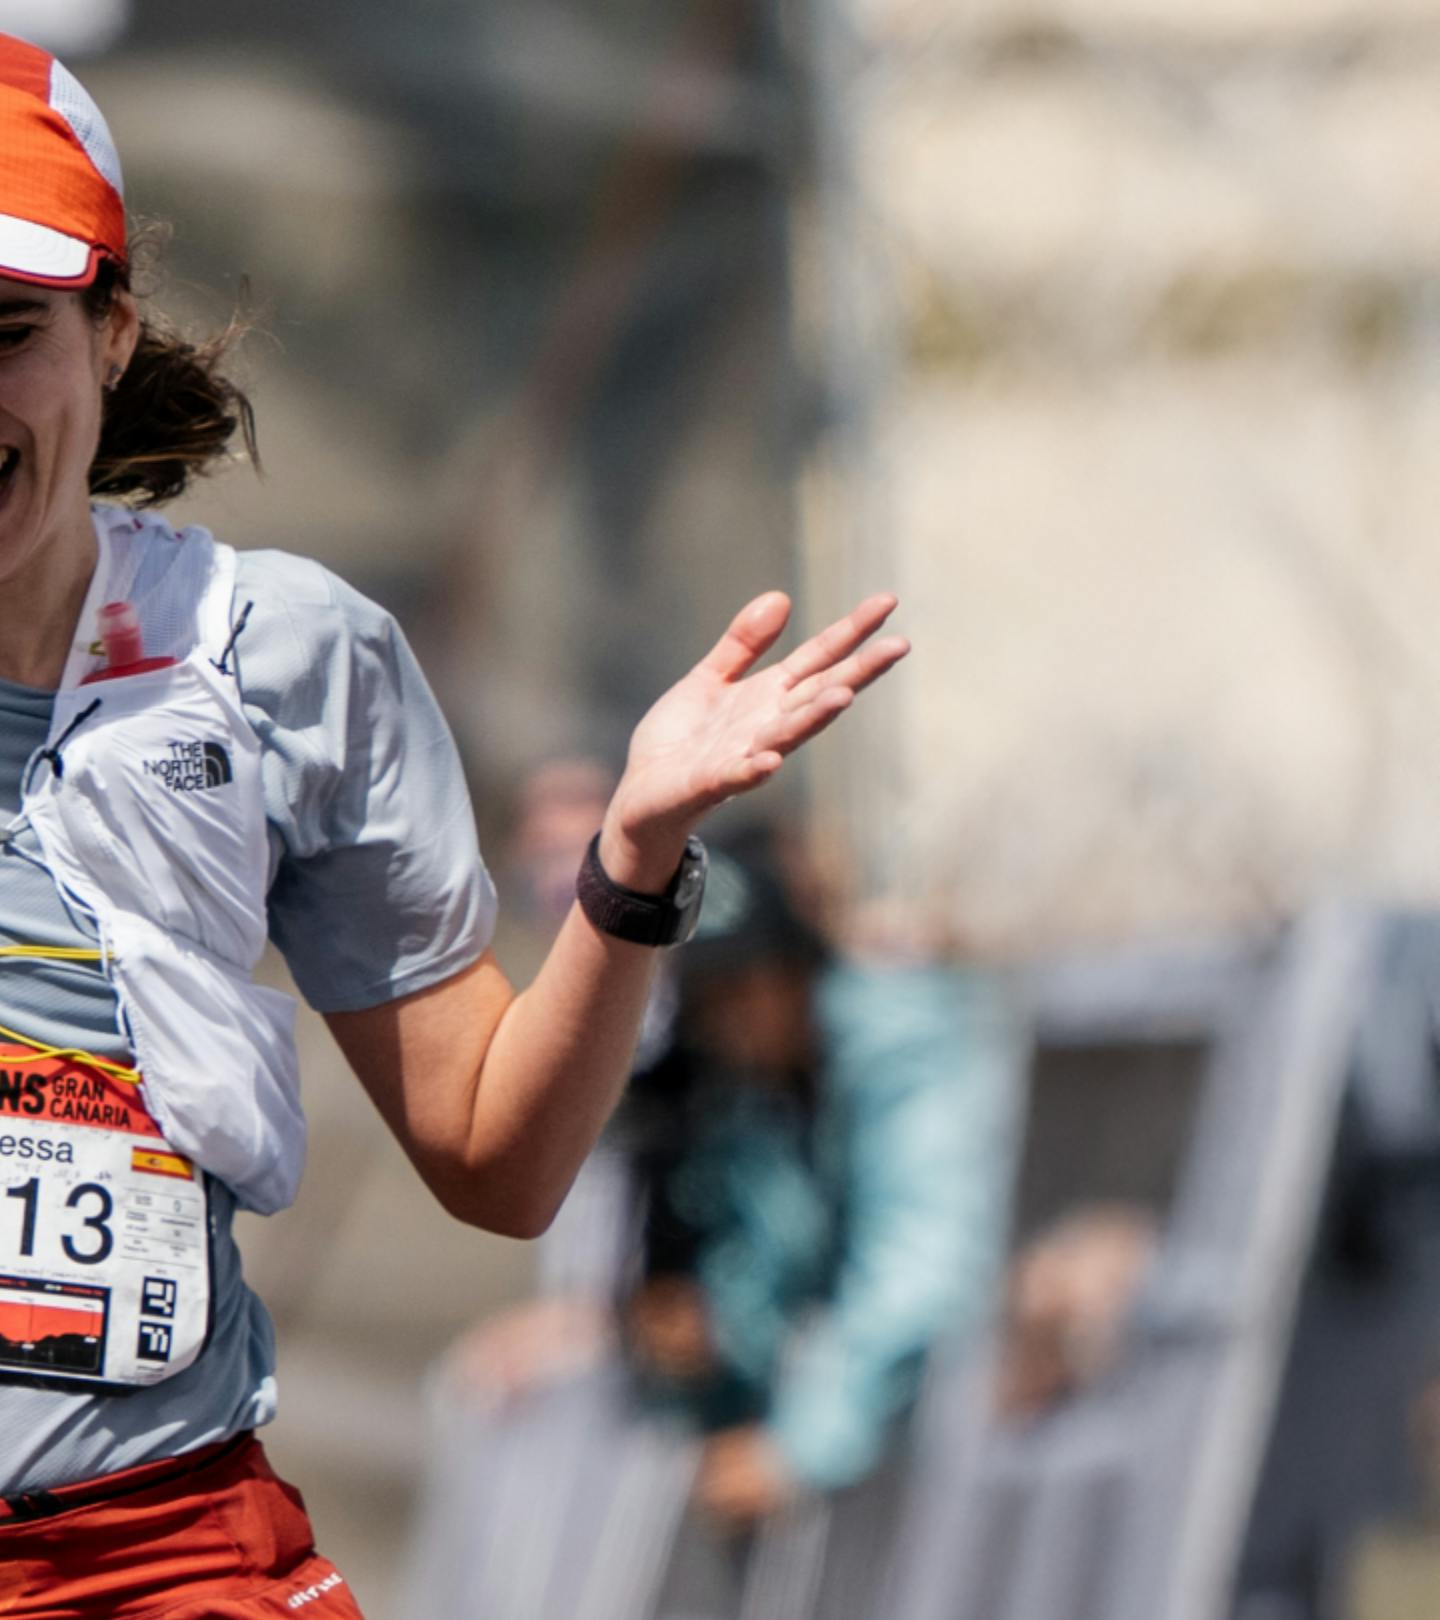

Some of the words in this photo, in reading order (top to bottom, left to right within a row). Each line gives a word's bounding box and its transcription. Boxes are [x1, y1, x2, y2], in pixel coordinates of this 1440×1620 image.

[168, 740, 202, 759] THE
[143, 759, 203, 776] NORTH
[165, 775, 205, 792] FACE
[52, 1076, 106, 1102] GRAN
[50, 1098, 131, 1129] CANARIA
